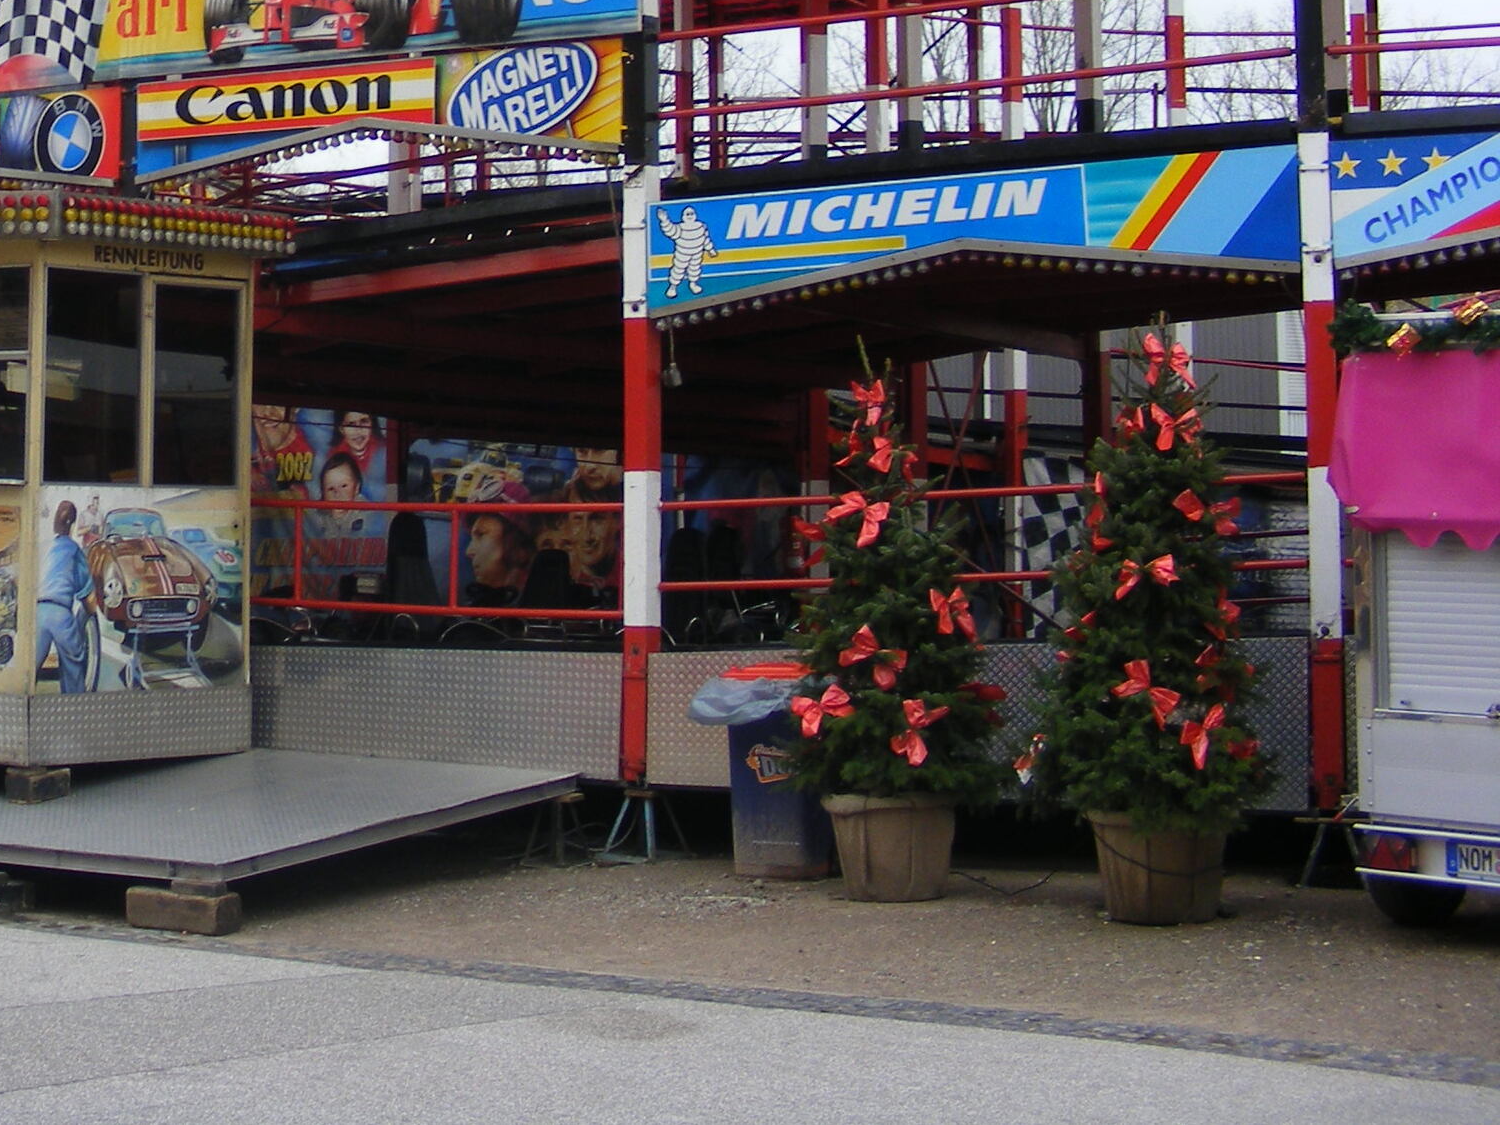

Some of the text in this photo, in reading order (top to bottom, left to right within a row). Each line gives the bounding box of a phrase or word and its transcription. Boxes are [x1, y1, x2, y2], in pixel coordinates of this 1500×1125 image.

[175, 73, 392, 125] Canon
[459, 47, 584, 128] MAGNETI
[52, 99, 103, 139] BMW
[725, 177, 1048, 240] MICHELIN
[1364, 156, 1500, 244] CHAMPIO
[94, 245, 204, 271] RENNLEITUNG
[275, 452, 314, 482] 2002
[1459, 847, 1493, 872] NOM
